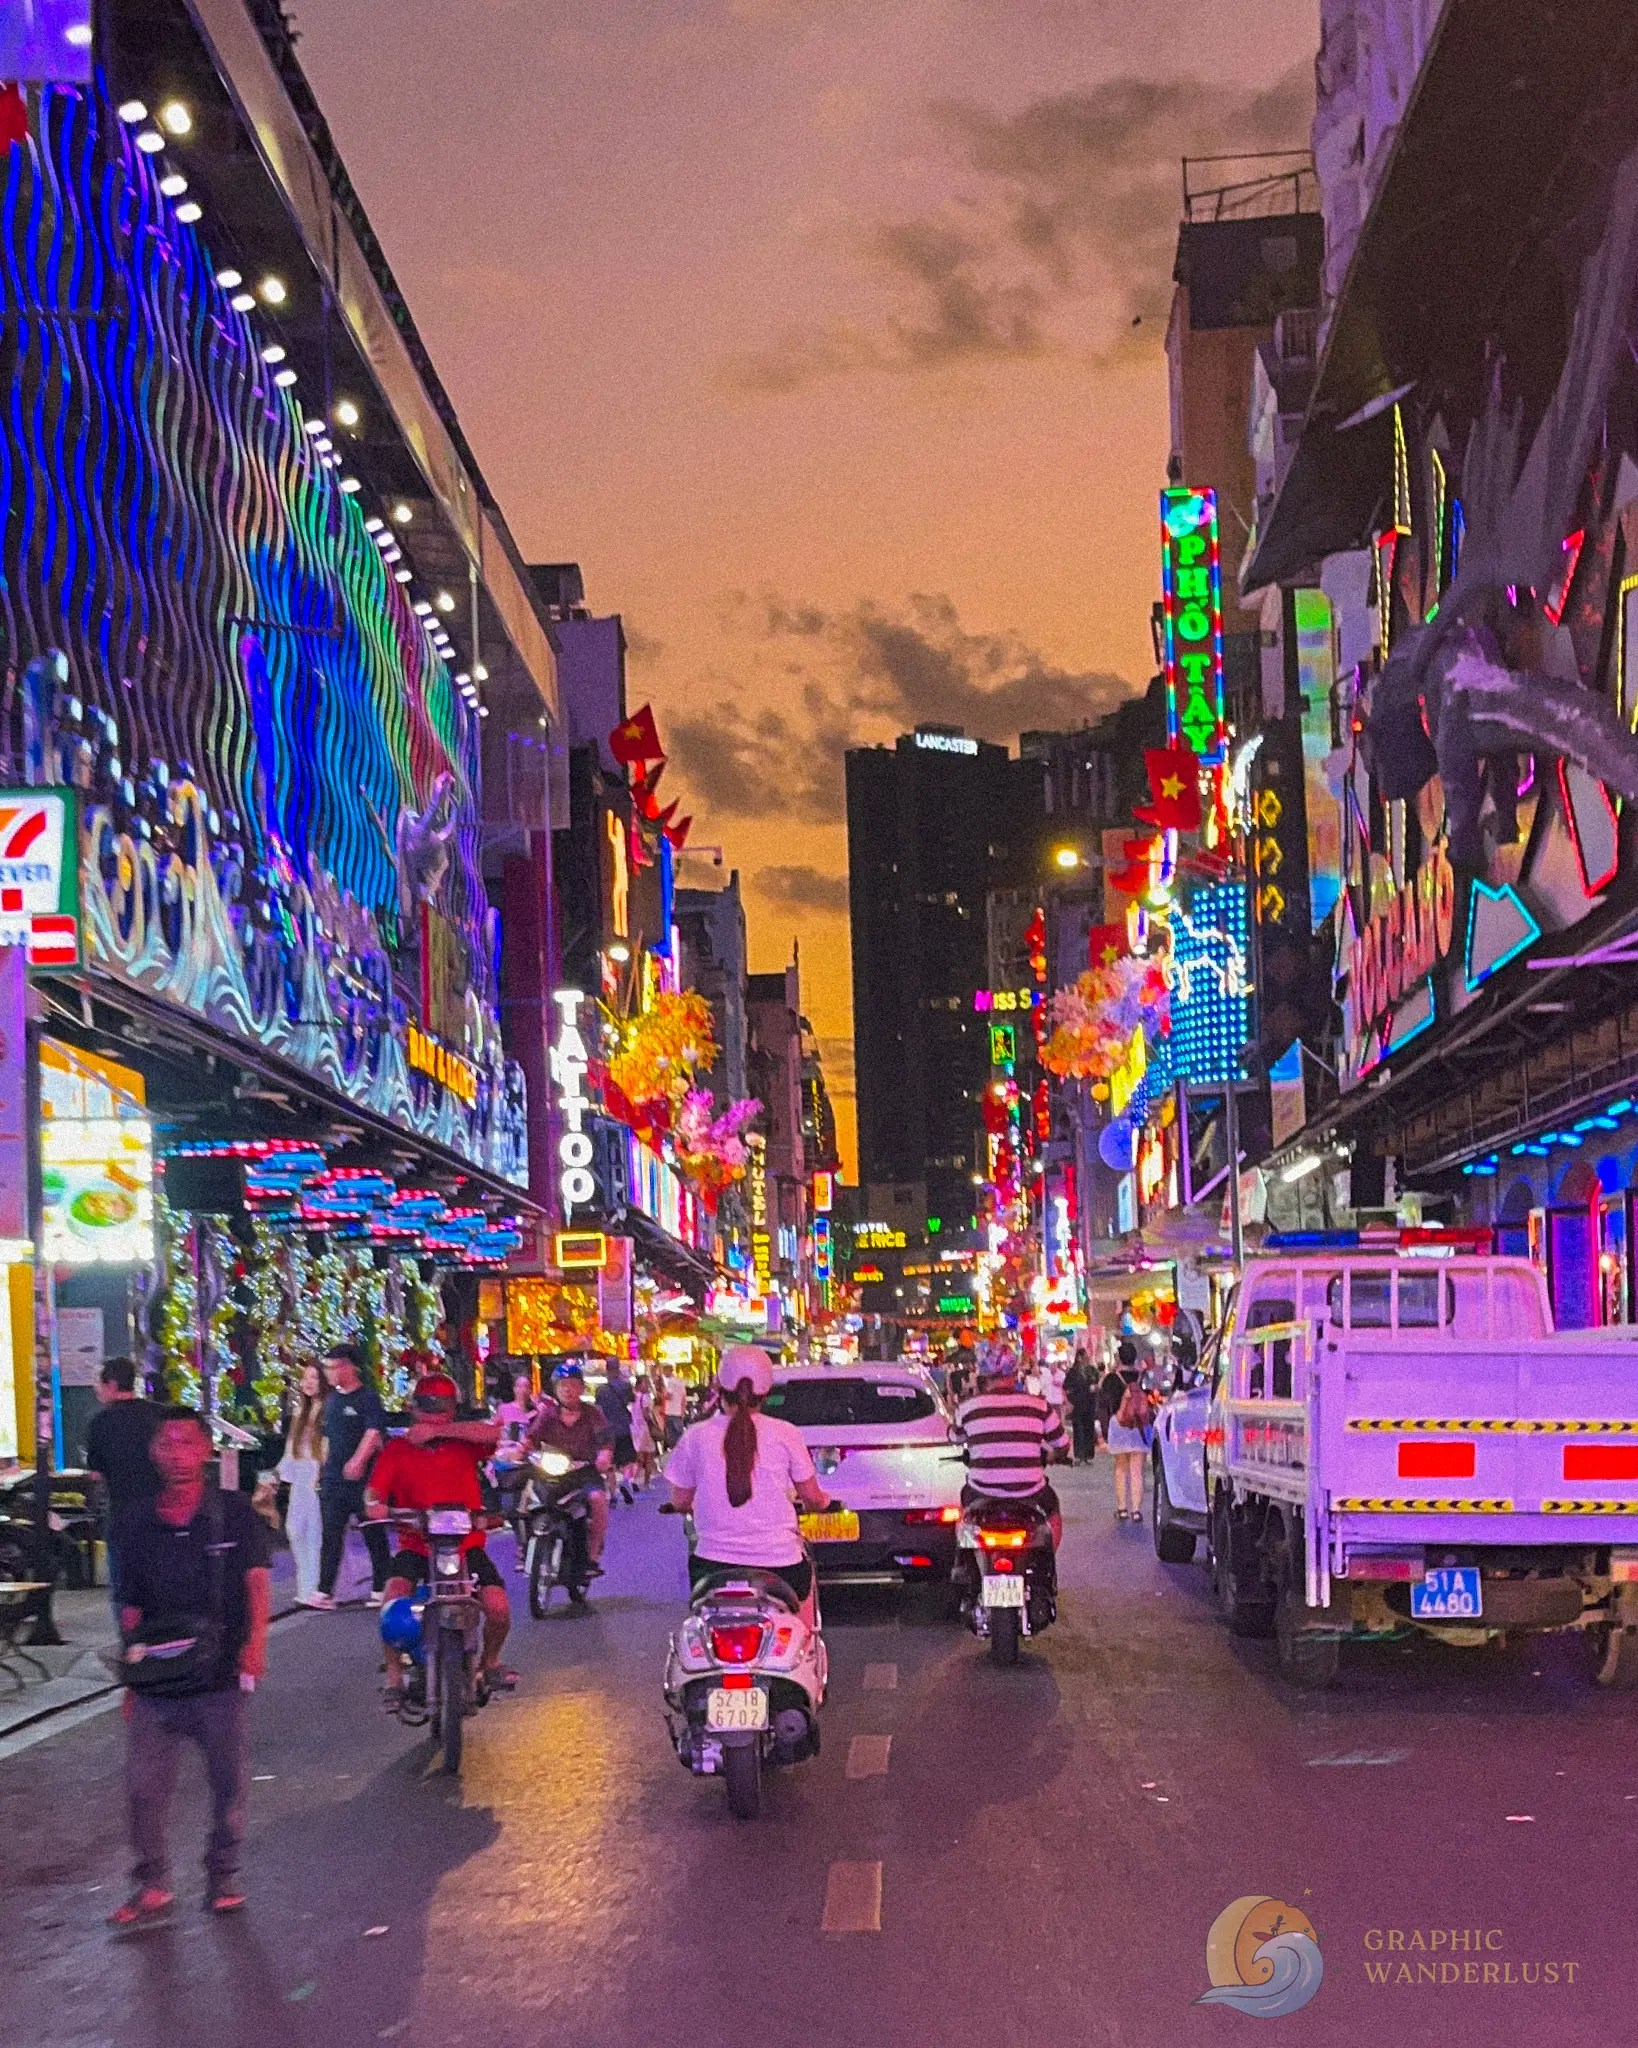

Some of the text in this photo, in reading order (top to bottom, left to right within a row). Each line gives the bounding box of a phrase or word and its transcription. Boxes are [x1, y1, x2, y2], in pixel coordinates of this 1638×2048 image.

[915, 733, 978, 756] LANCASTER
[553, 989, 595, 1203] TATTOO
[1425, 1570, 1466, 1592] 51A
[1420, 1591, 1473, 1613] 4480
[715, 1709, 759, 1727] 6702
